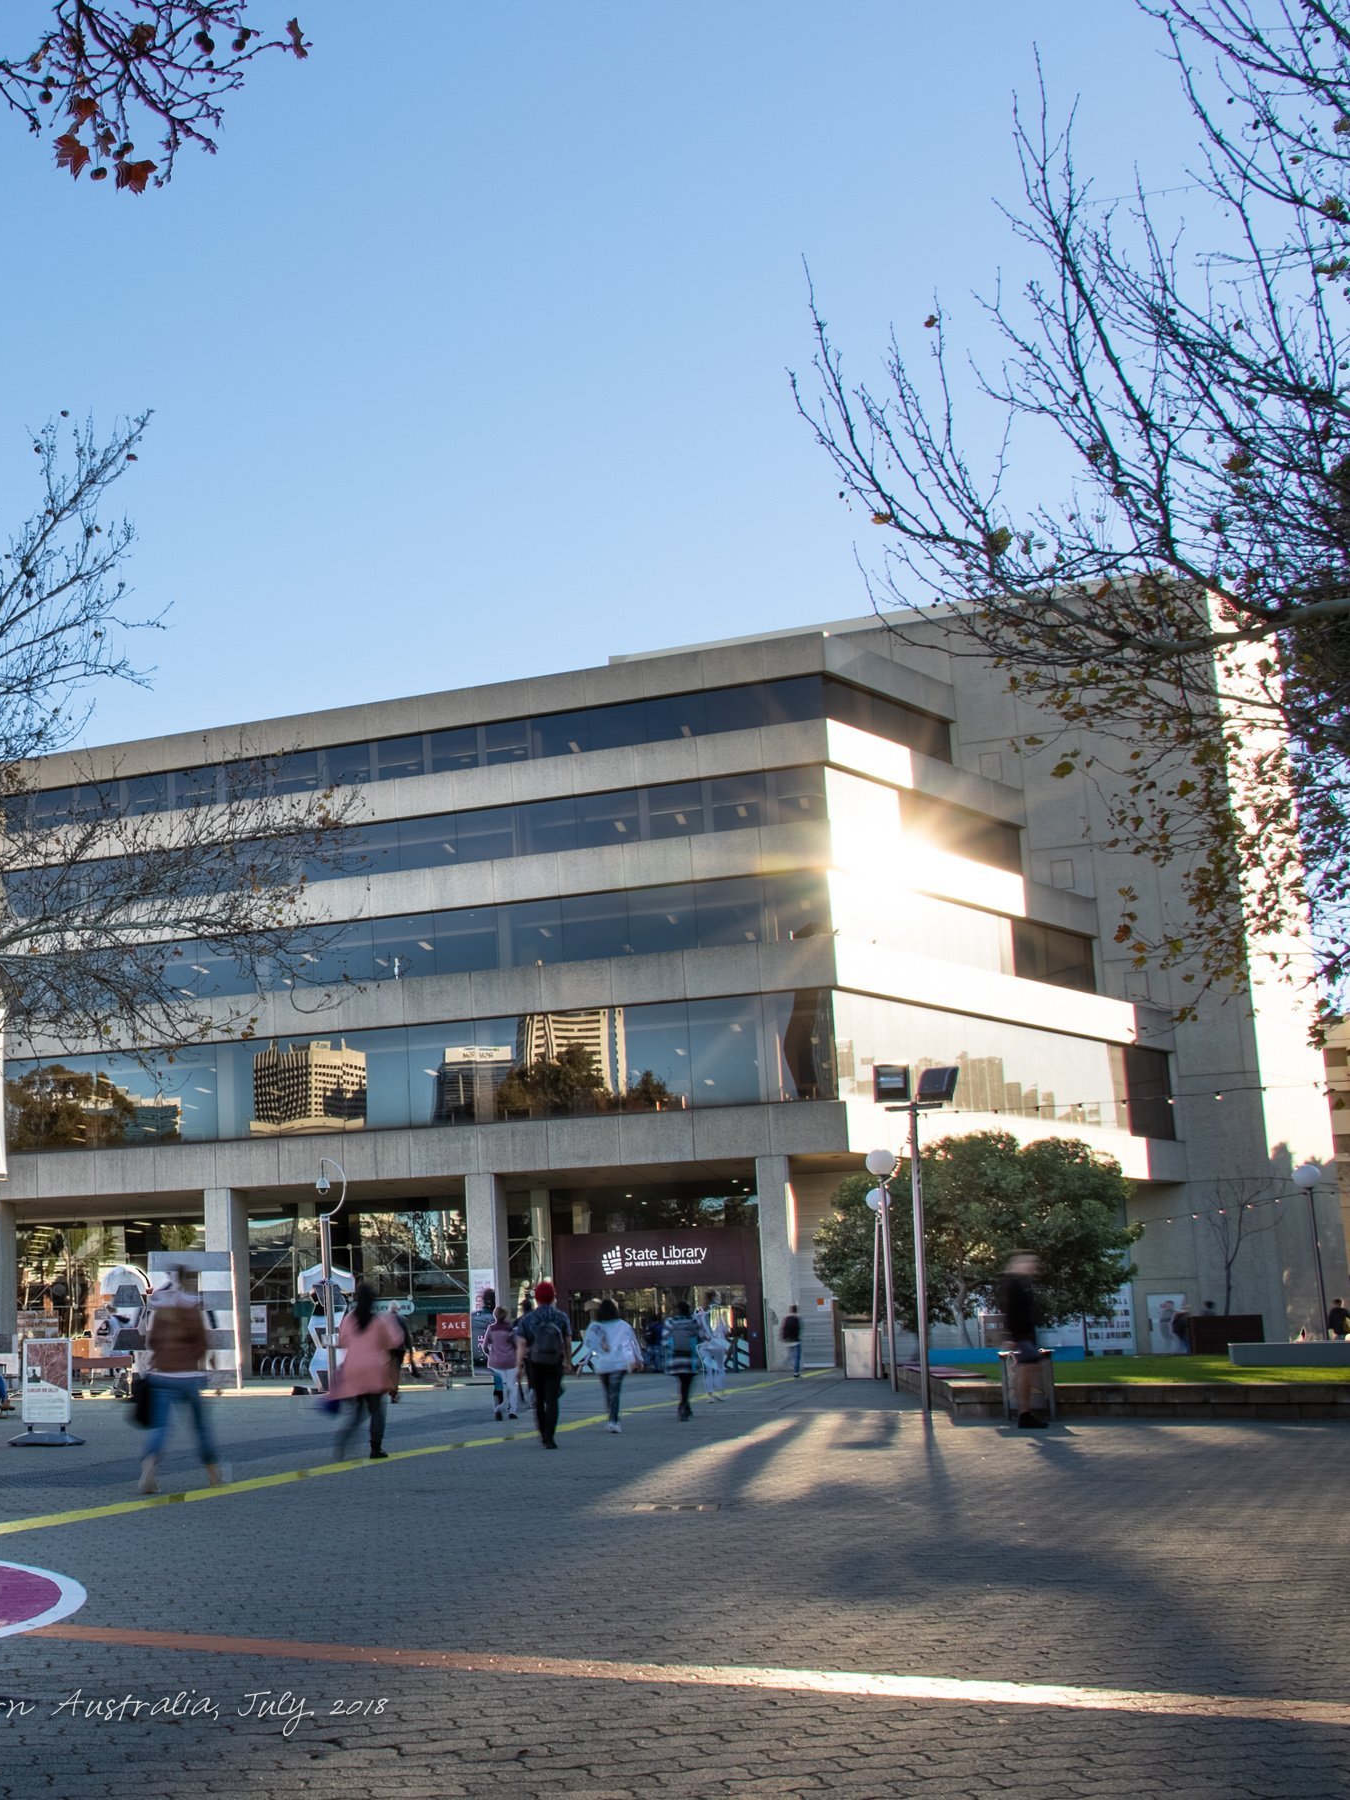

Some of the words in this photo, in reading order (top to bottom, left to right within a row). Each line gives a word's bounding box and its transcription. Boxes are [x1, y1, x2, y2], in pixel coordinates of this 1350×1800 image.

[624, 1247, 658, 1261] State
[662, 1245, 707, 1260] Library
[441, 1321, 467, 1329] SALE
